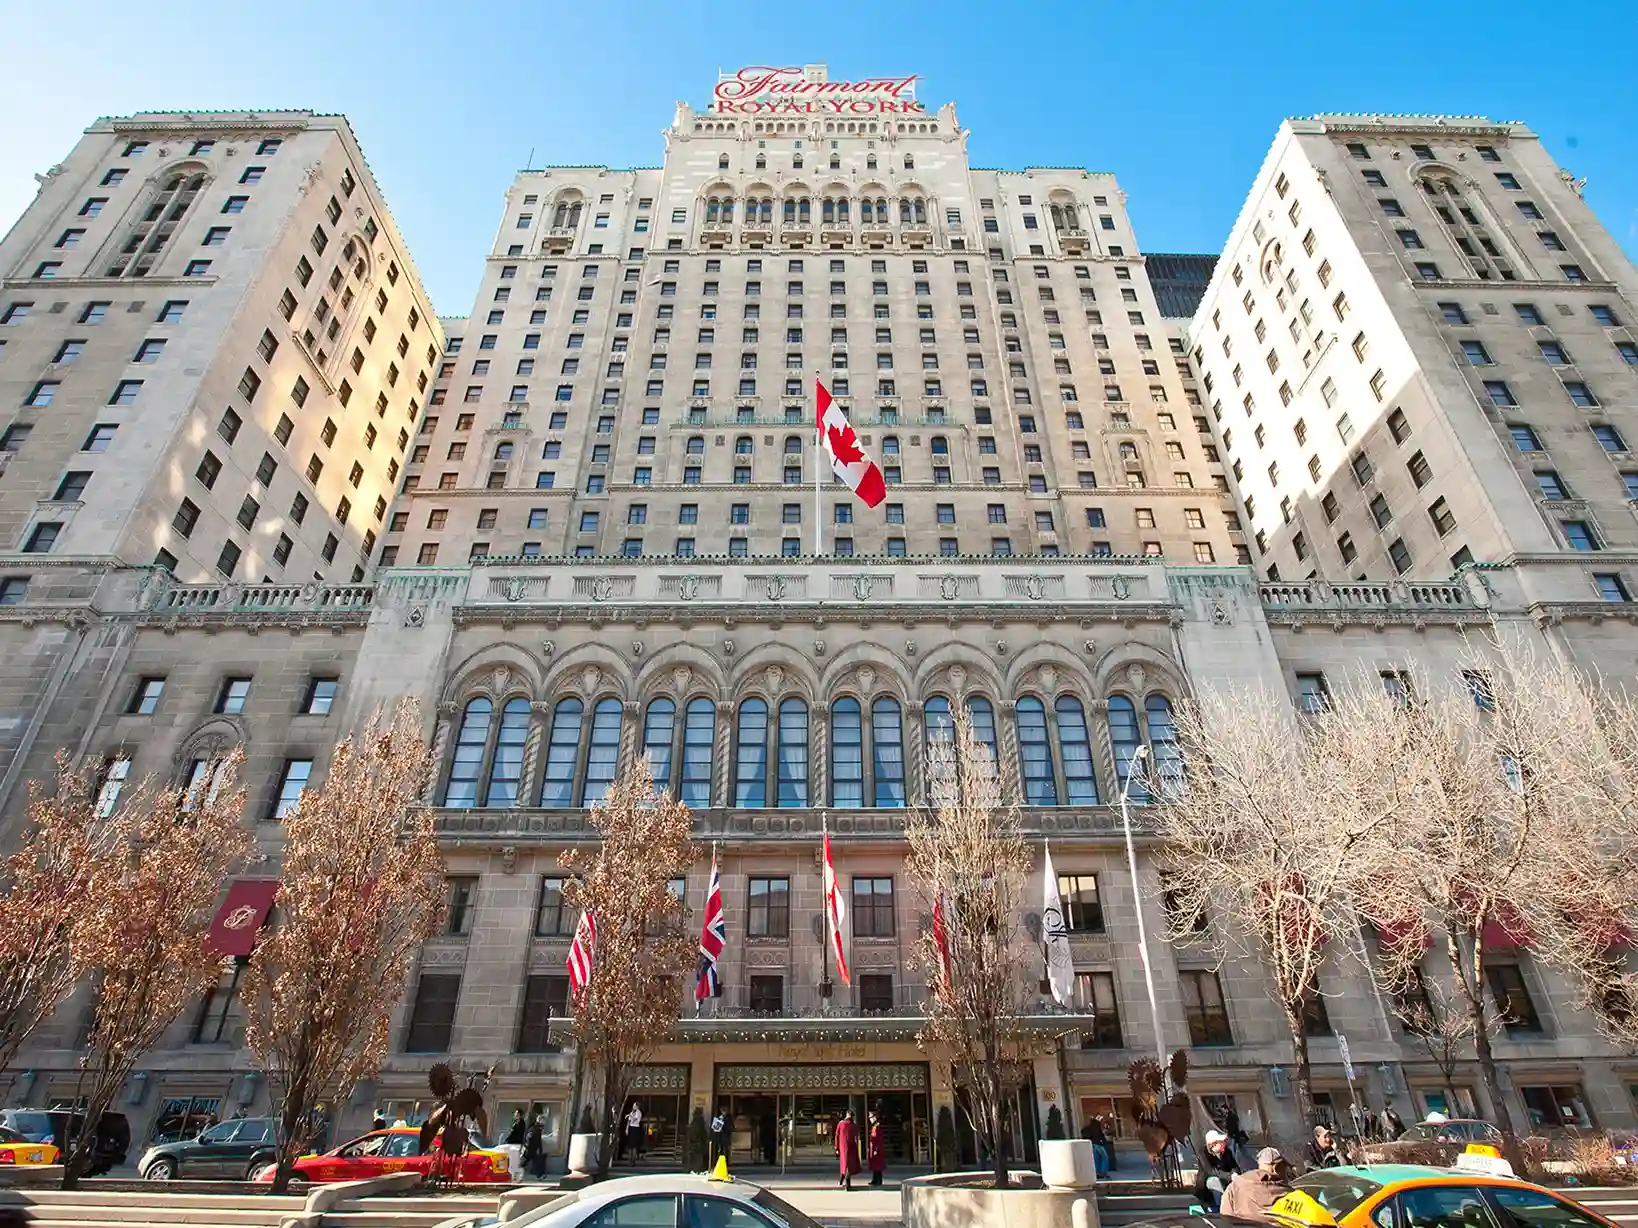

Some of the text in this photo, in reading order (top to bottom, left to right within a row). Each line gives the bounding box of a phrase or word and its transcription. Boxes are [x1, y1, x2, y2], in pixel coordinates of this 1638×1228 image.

[715, 66, 925, 100] Fairmont
[717, 100, 925, 113] ROYAL YORK
[1283, 1199, 1304, 1216] TAXI
